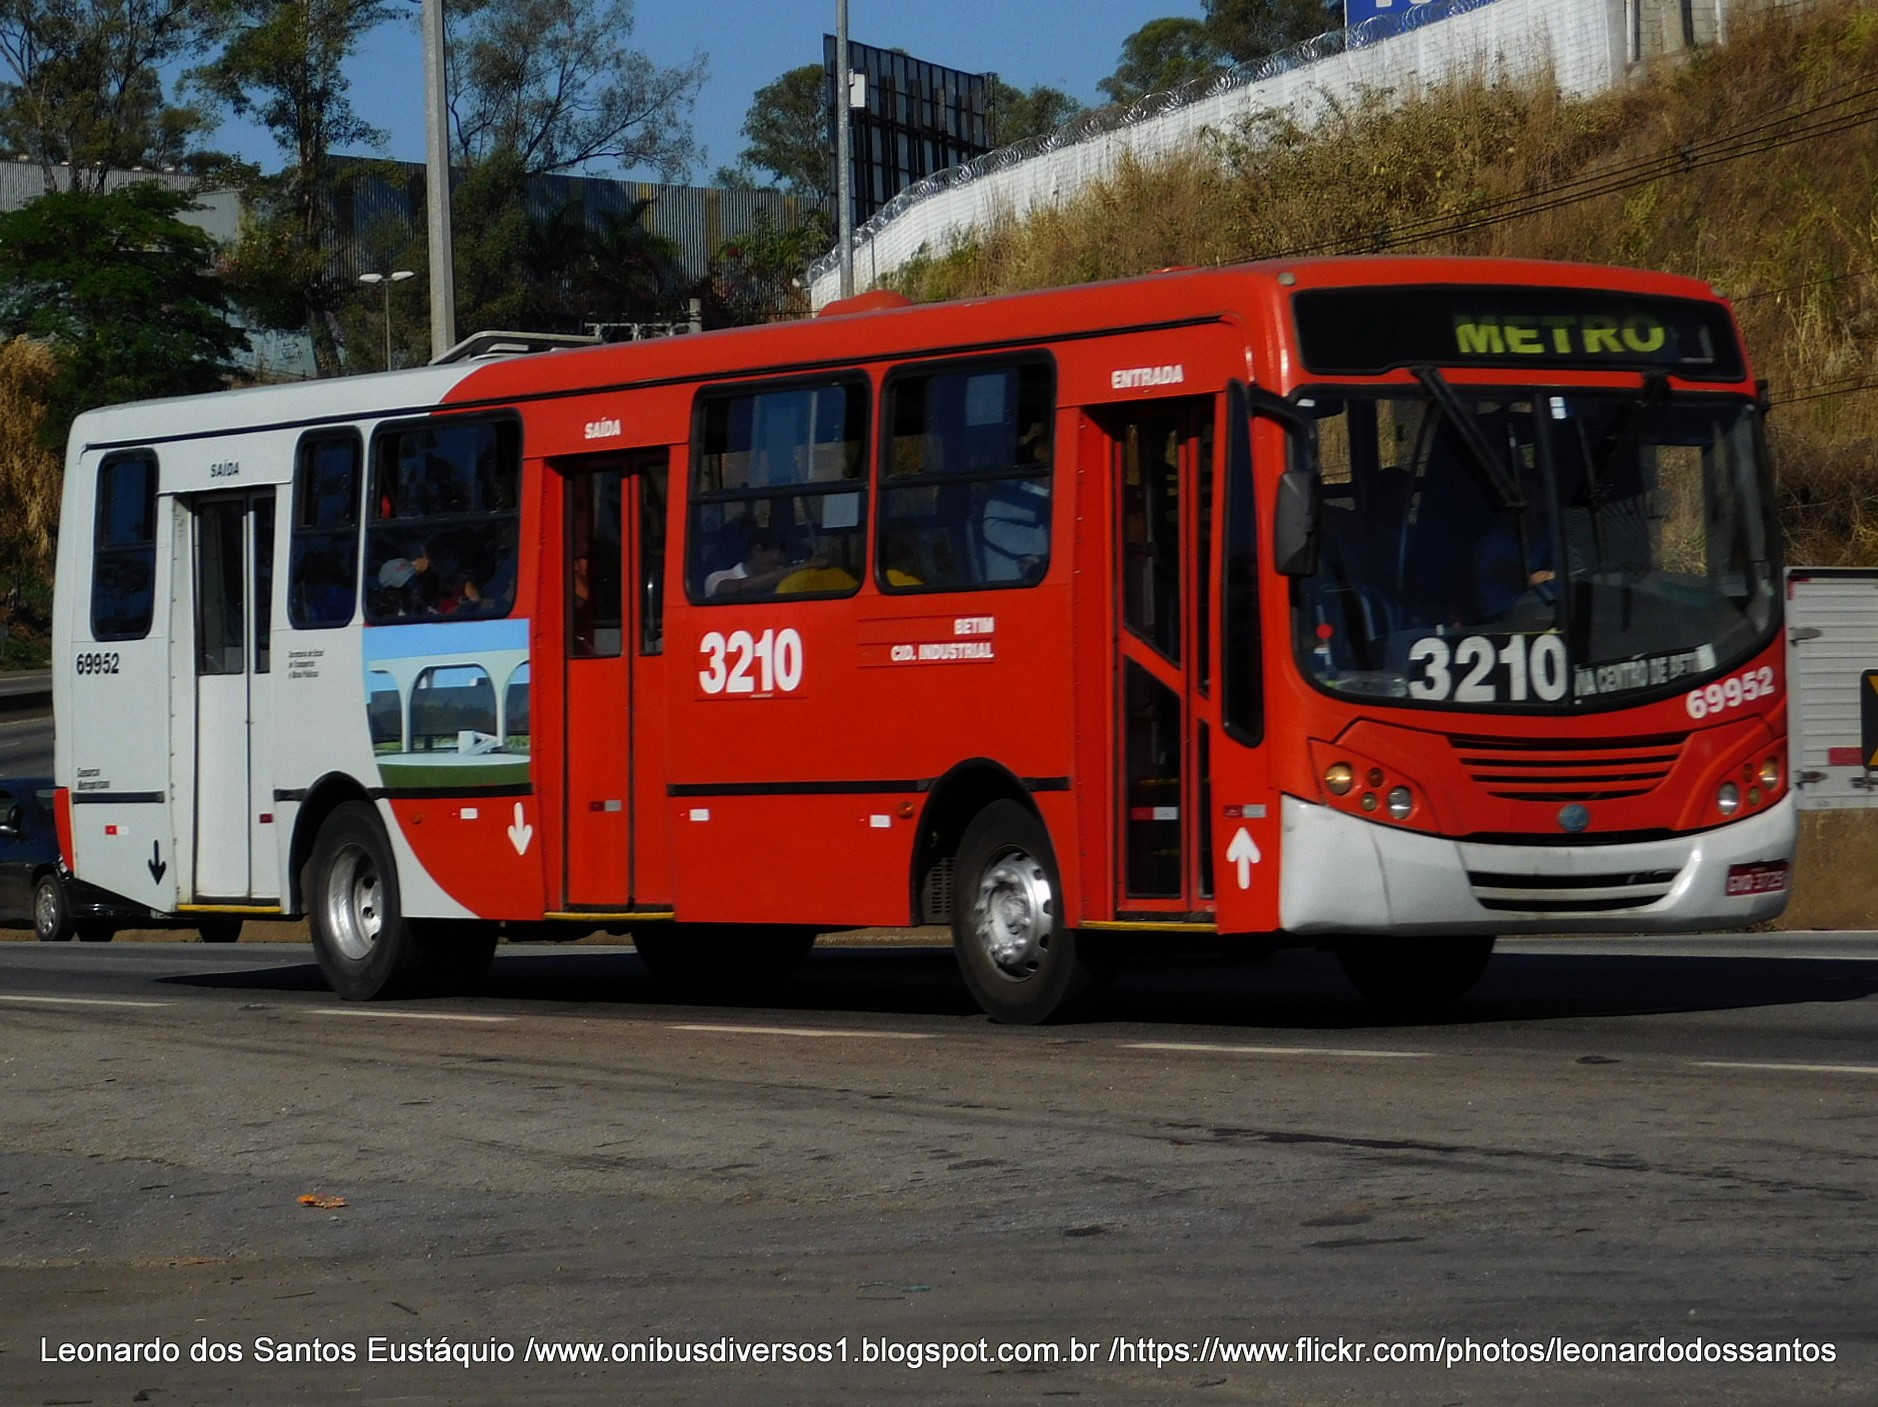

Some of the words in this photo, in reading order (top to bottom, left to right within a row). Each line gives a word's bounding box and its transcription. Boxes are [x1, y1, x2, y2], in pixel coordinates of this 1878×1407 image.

[1455, 315, 1665, 353] METRO
[1111, 364, 1184, 389] ENTRADA
[584, 418, 621, 440] SAÍDA
[210, 461, 240, 478] SAÍDA
[75, 651, 120, 676] 69952
[699, 627, 803, 695] 3210
[918, 641, 995, 661] INDUSTRIAL
[1408, 633, 1568, 702] 3210
[1685, 664, 1776, 720] 69952
